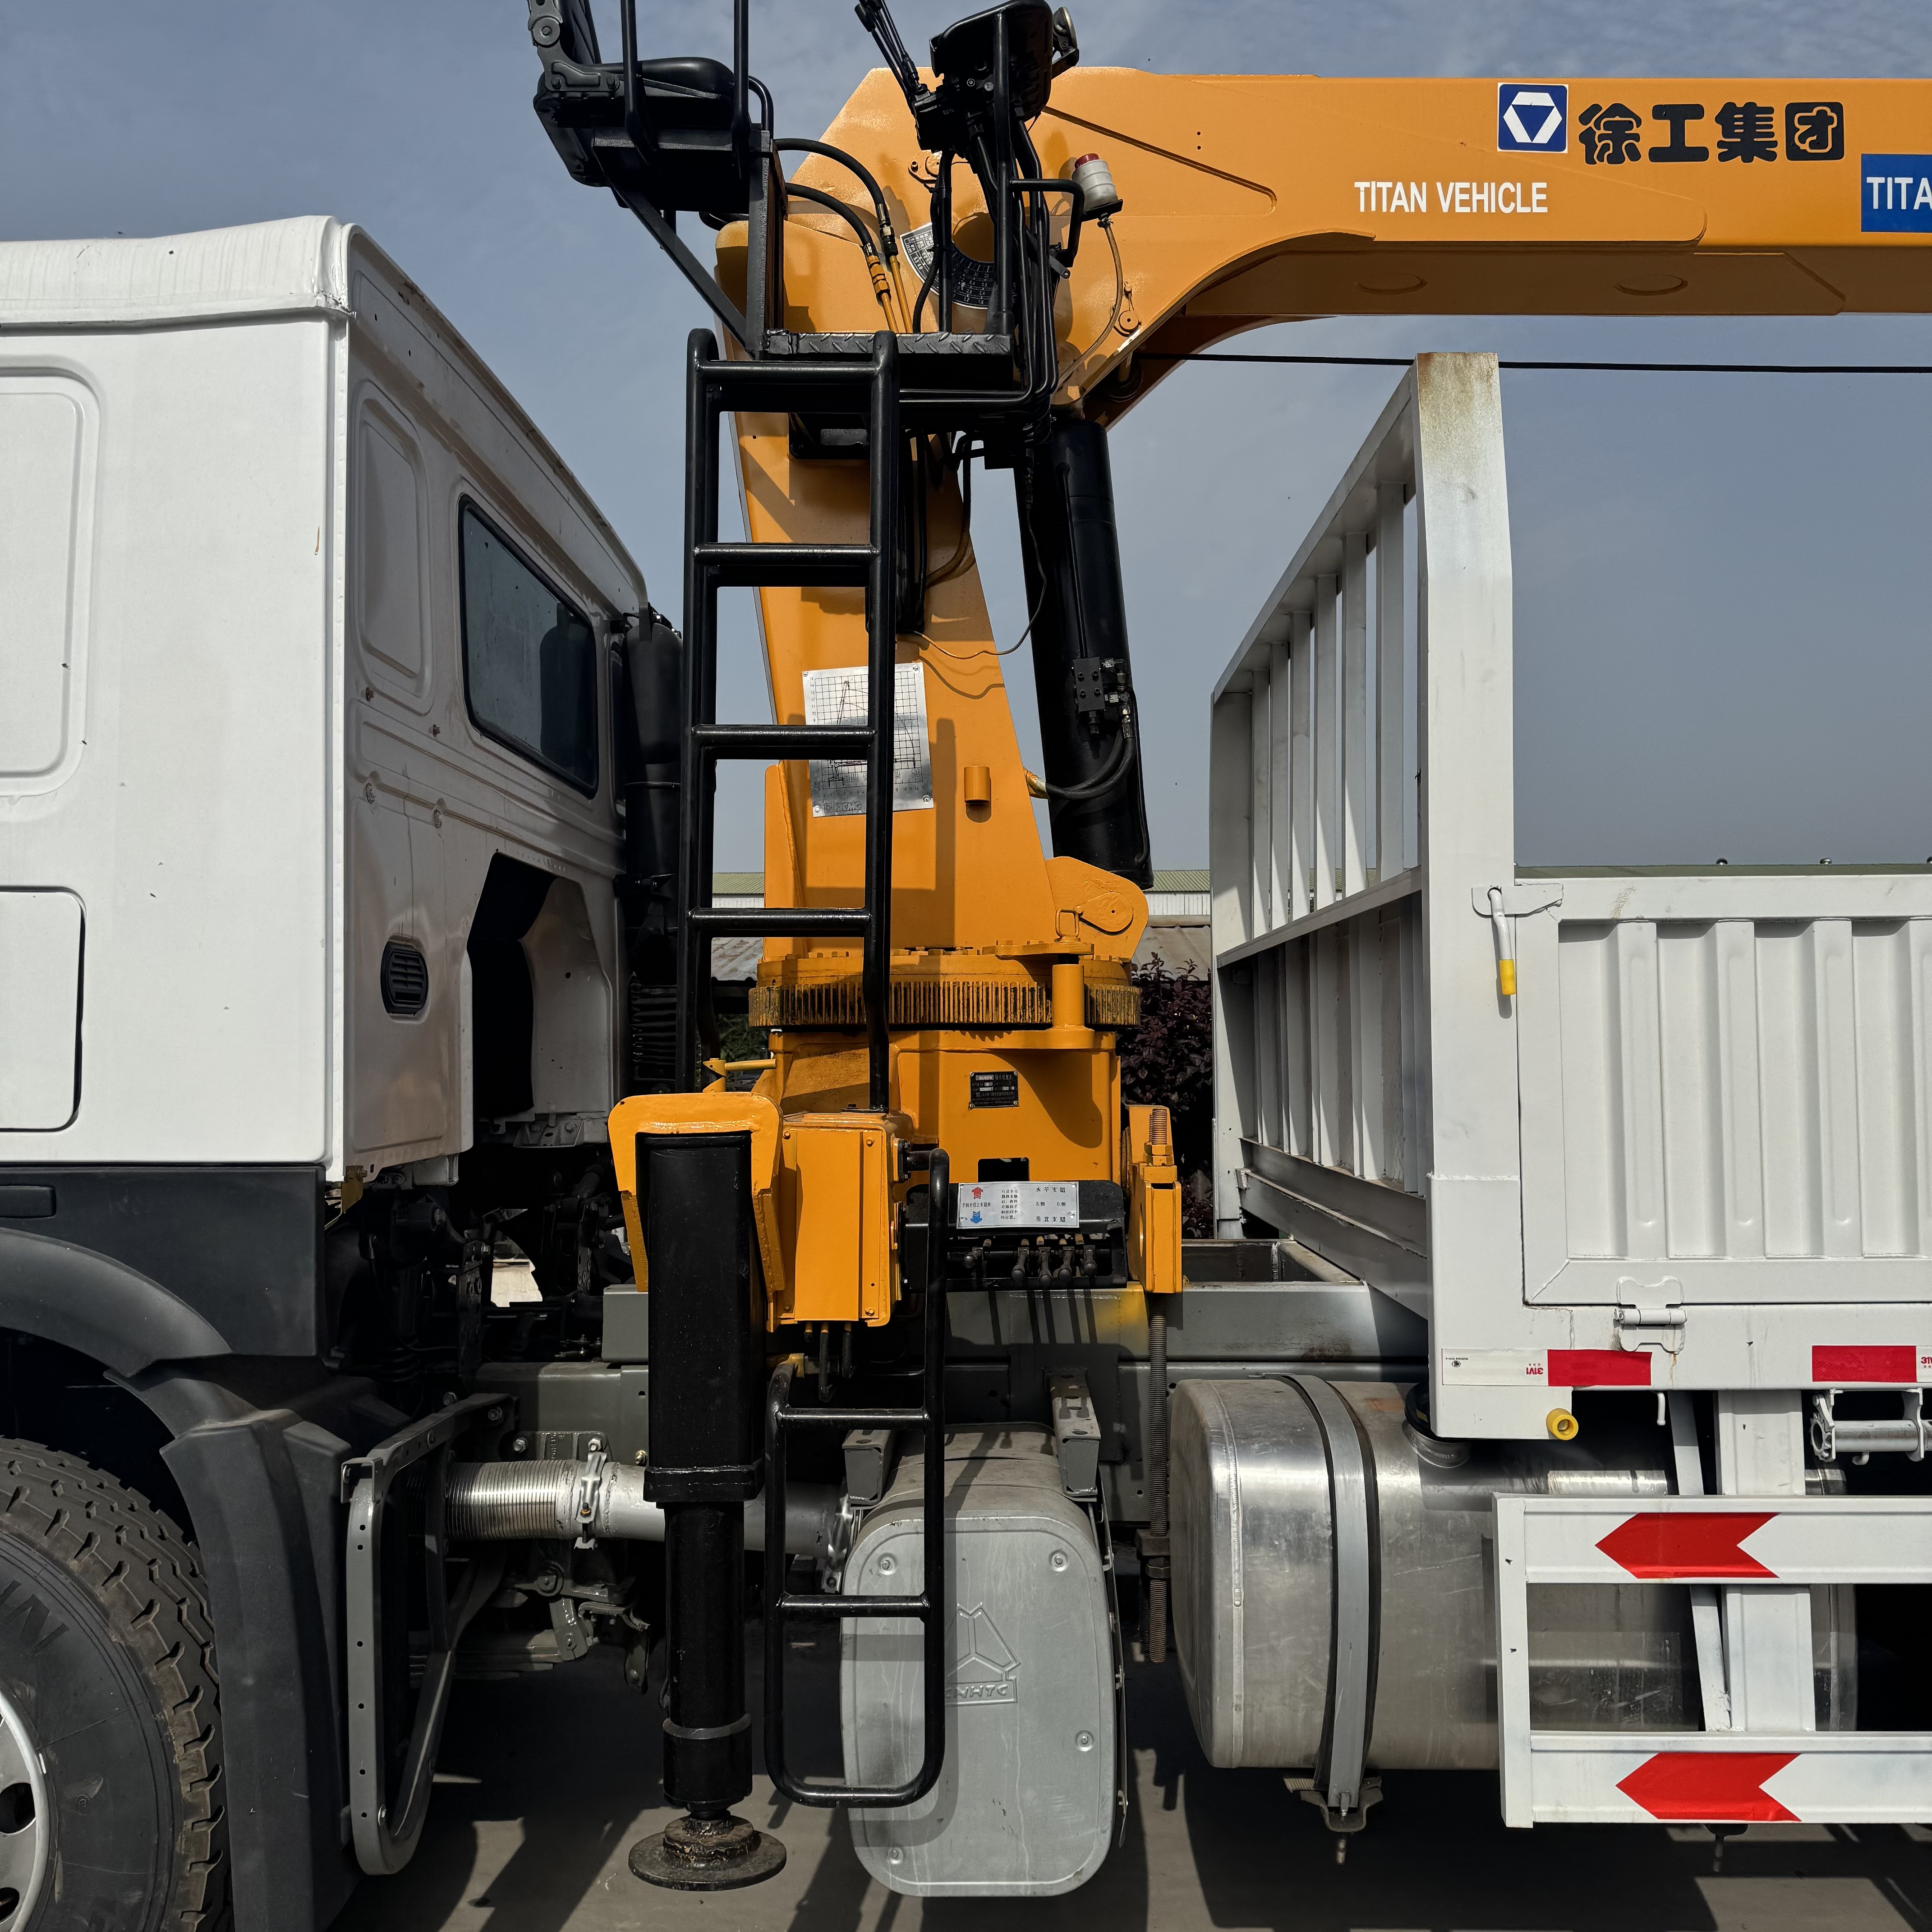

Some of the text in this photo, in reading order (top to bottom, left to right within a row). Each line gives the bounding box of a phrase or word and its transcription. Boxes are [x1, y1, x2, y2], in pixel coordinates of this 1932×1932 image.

[1578, 102, 1844, 164] 徐工集团
[1354, 181, 1548, 213] TITAN VEHICLE
[1867, 177, 1932, 210] TITA
